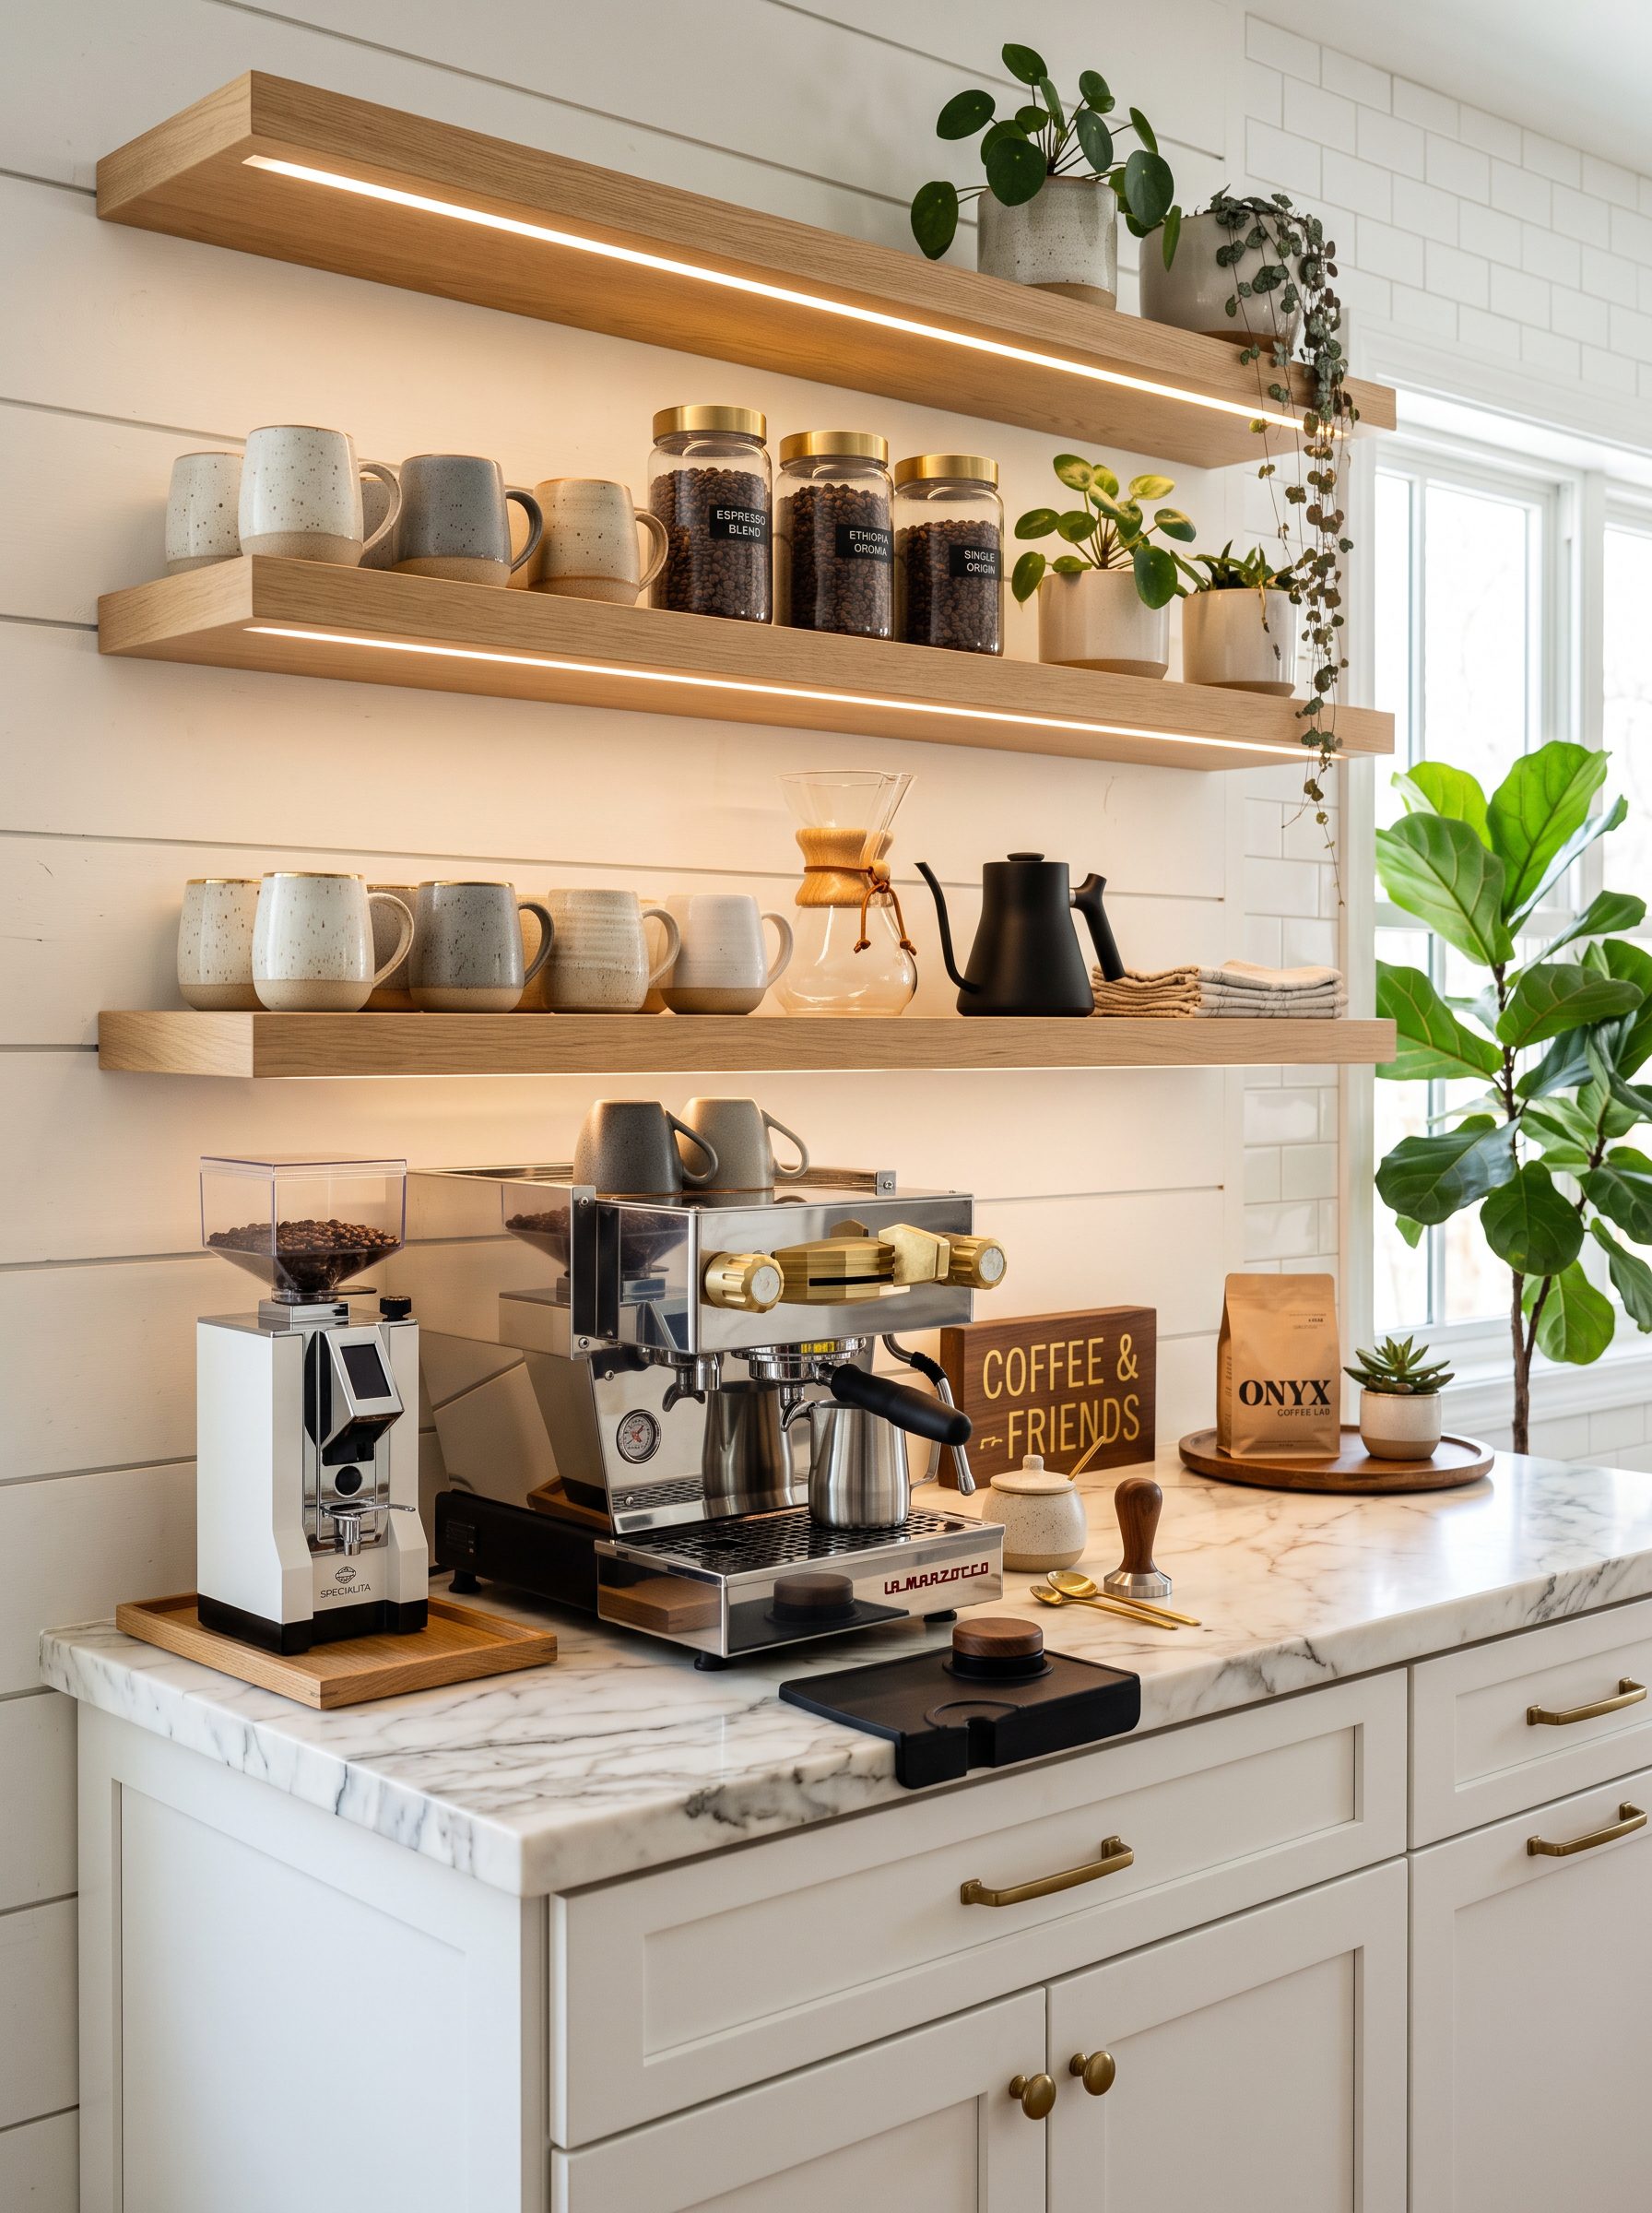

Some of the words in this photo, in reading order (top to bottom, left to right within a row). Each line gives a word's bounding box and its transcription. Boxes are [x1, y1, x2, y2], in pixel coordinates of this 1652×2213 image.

[716, 510, 766, 526] ESPRESSO
[728, 524, 761, 538] BLEND
[849, 530, 889, 545] ETHIOPIA
[854, 543, 888, 557] OROMIA
[964, 550, 996, 562] SINGLE
[966, 562, 996, 574] ORIGIN
[983, 1337, 1104, 1400] COFFEE
[1116, 1333, 1139, 1382] &
[1238, 1379, 1332, 1406] ONYX
[1277, 1408, 1312, 1417] COFFEE
[1008, 1393, 1140, 1460] FRIENDS
[320, 1583, 372, 1599] SPECIALITA
[884, 1580, 901, 1595] LA
